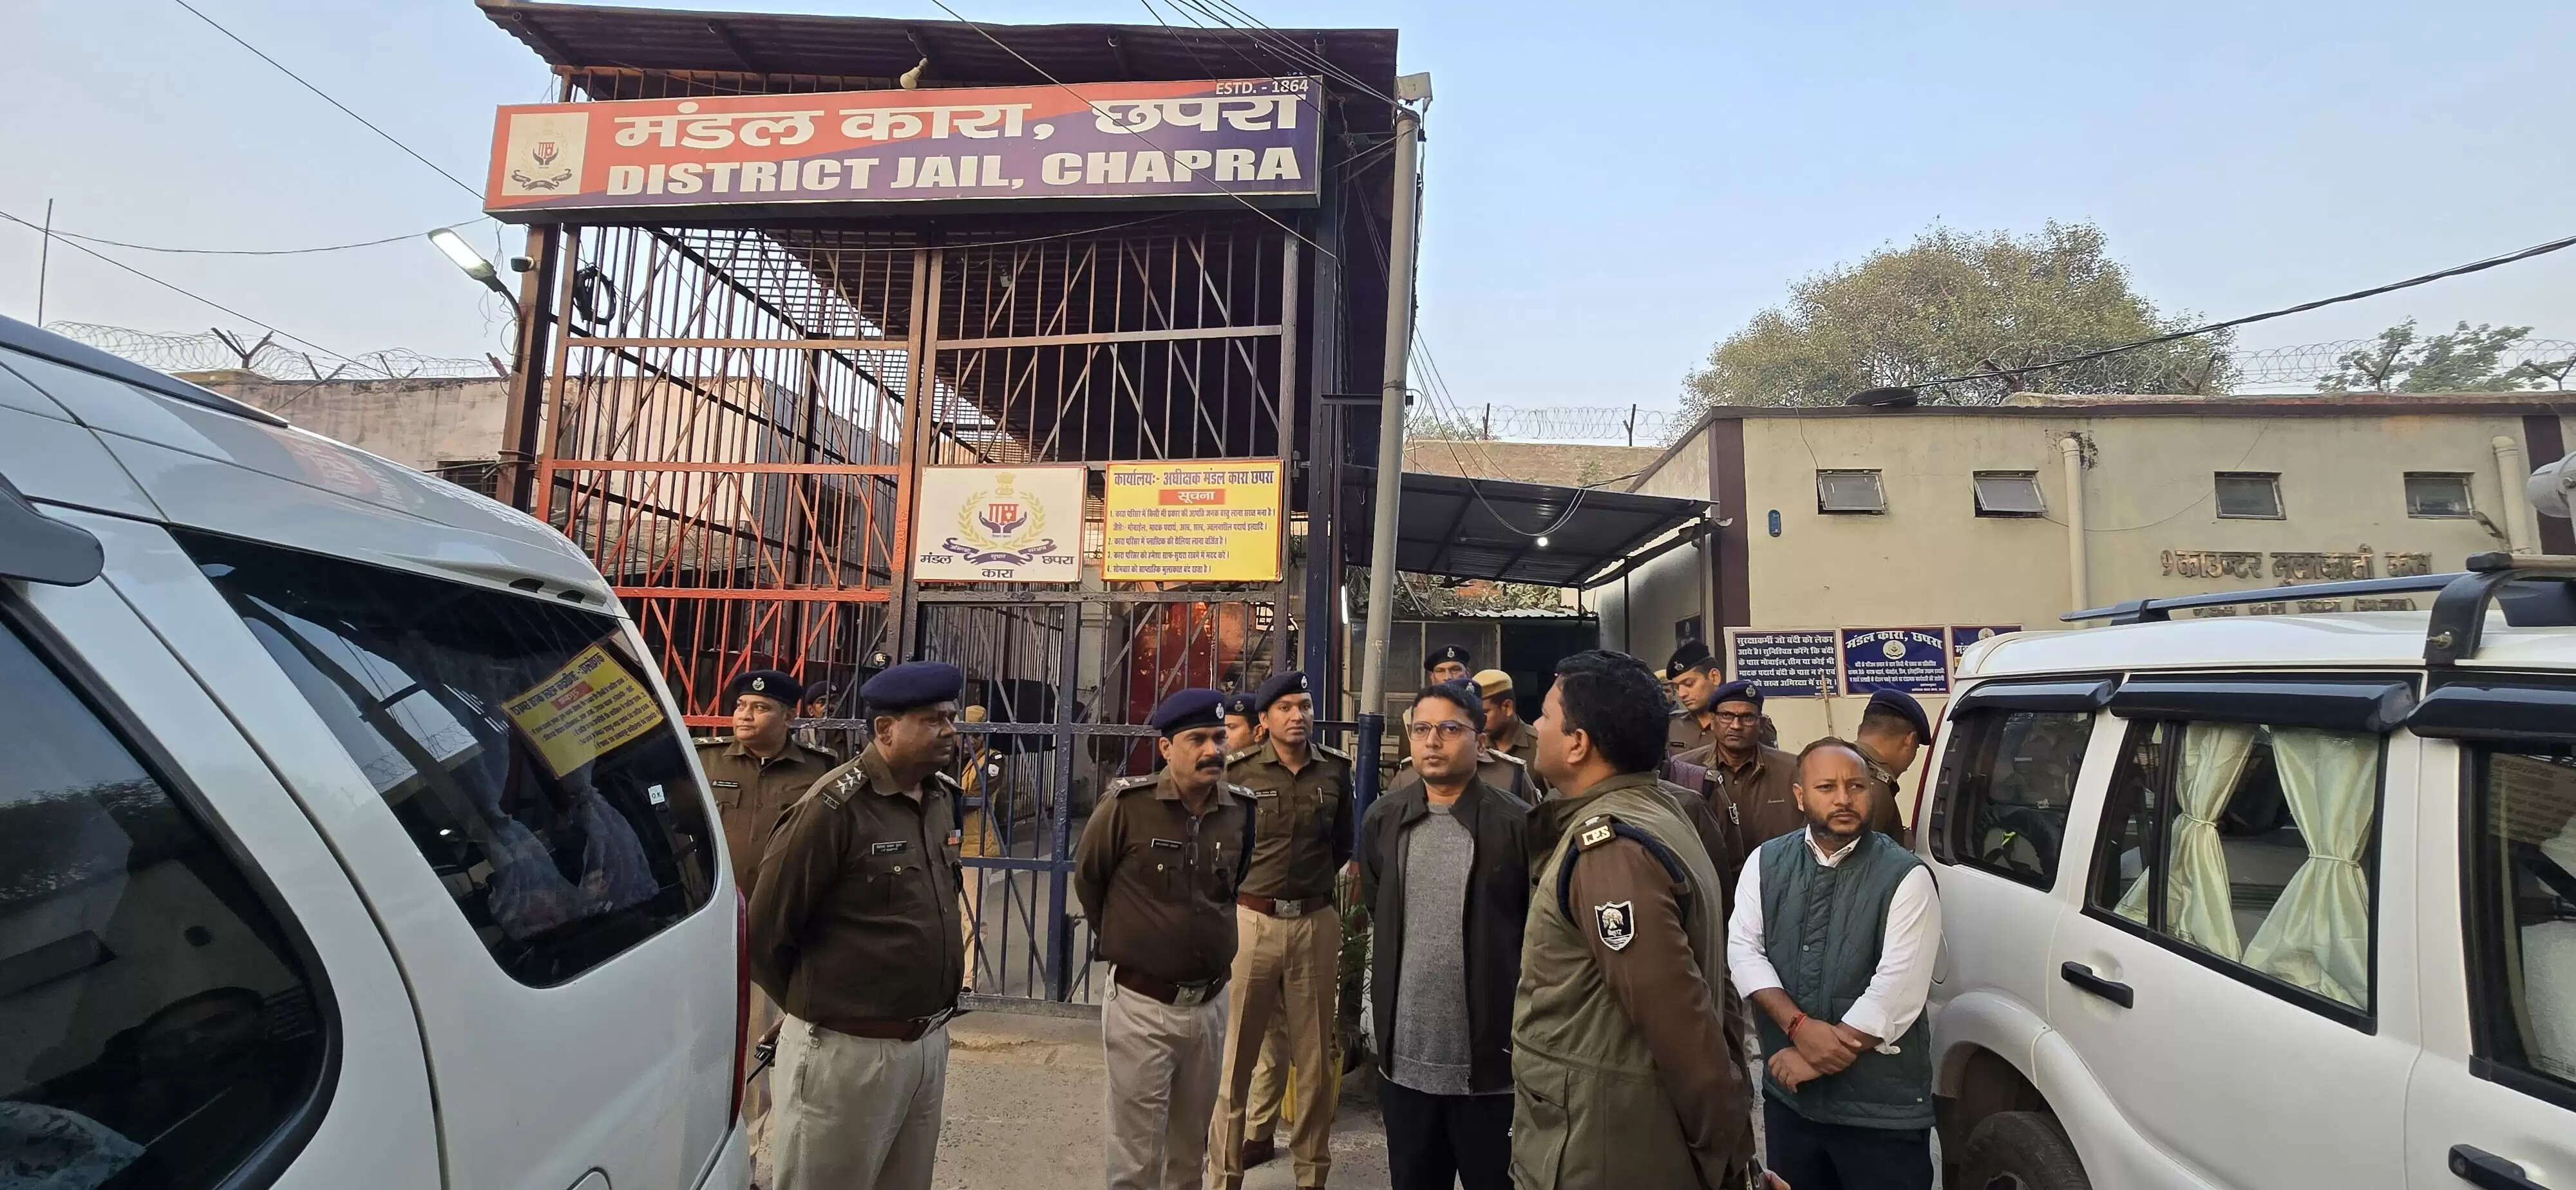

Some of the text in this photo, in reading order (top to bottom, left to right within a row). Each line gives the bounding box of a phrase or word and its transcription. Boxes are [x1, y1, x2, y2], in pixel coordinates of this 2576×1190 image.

[1215, 82, 1256, 95] ESTD.
[1272, 79, 1309, 93] 1864
[614, 94, 1306, 149] मंडल कारा, छपरा
[607, 147, 1302, 196] DISTRICT JAIL, CHAPRA
[1203, 468, 1226, 485] मंडल
[1227, 471, 1249, 484] कारा
[1251, 471, 1274, 484] छपरा
[1177, 491, 1216, 504] सूचना
[920, 552, 953, 565] मंडल
[1041, 555, 1075, 565] छपरा
[981, 568, 1014, 578] कारा
[1775, 635, 1785, 644] जो
[1803, 635, 1813, 643] को
[1814, 635, 1833, 643] लेकर
[1845, 632, 1875, 648] मंडल
[1911, 631, 1943, 649] छपरा
